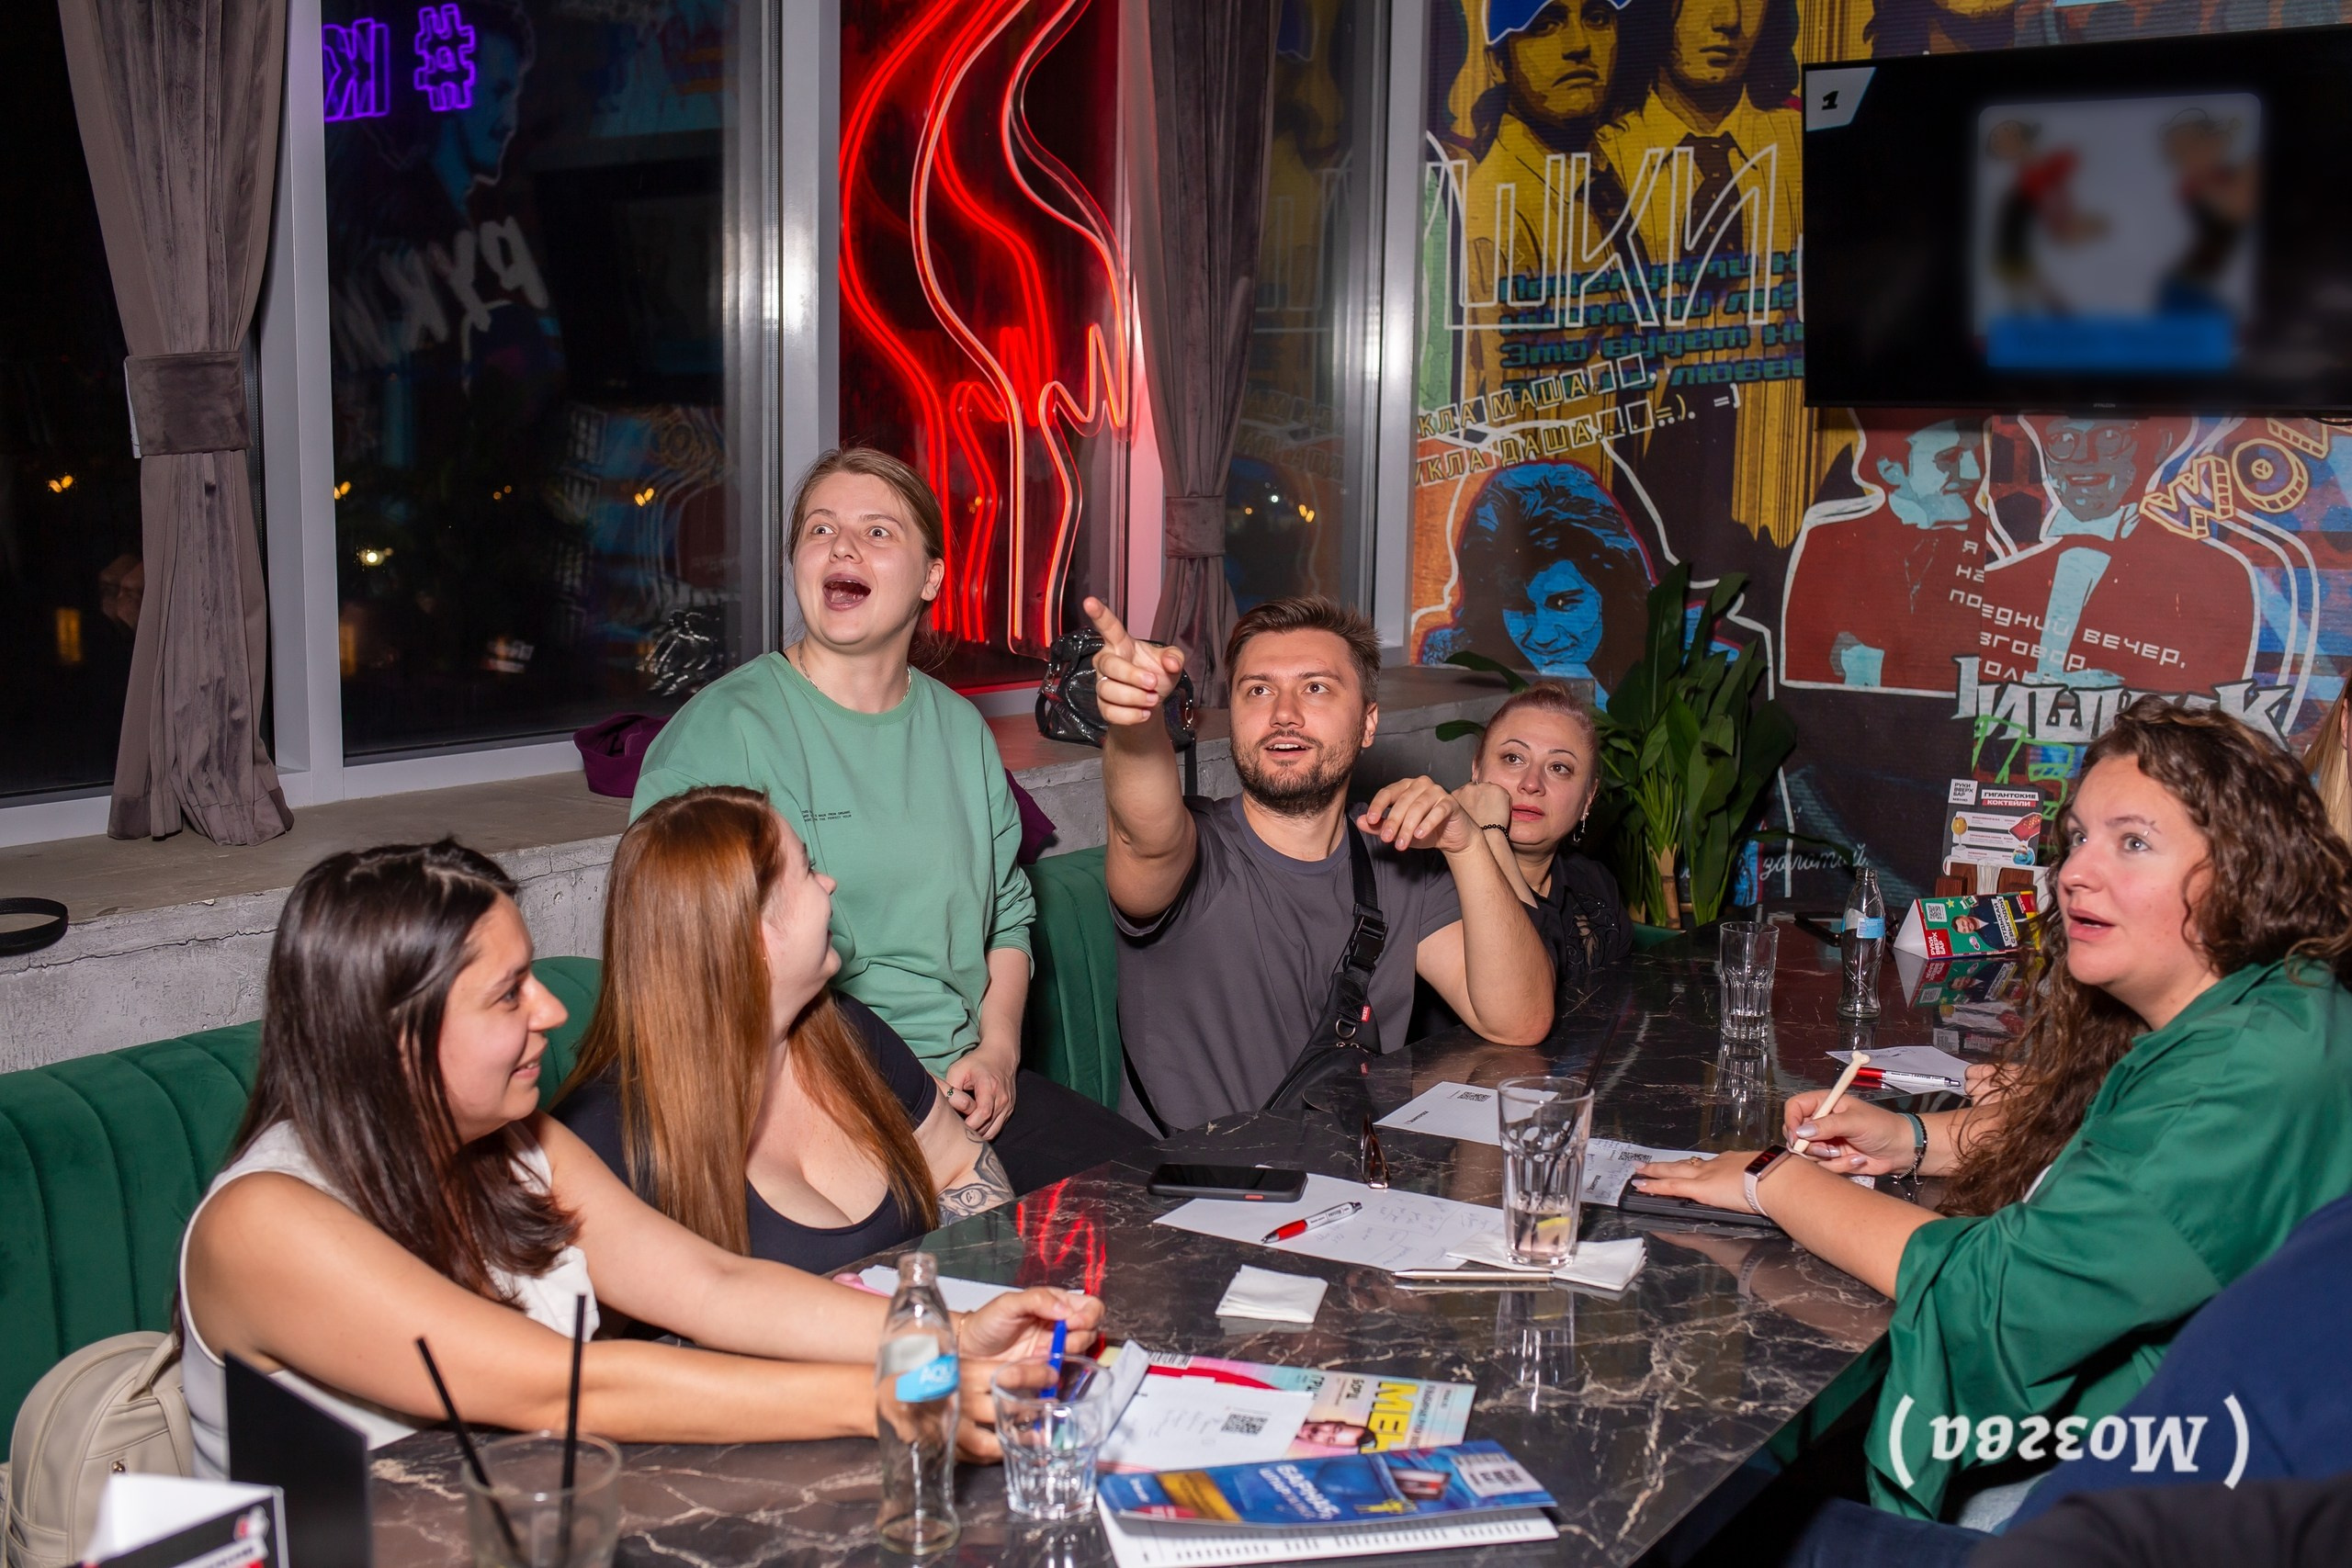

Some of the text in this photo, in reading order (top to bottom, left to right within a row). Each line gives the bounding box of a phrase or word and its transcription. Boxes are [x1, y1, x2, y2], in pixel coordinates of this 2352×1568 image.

[1822, 91, 1838, 110] 1
[1984, 792, 2037, 800] ГИГАНТСКИЕ
[1986, 799, 2031, 807] КОКТЕЙЛИ
[1994, 902, 2008, 942] ОТДЫХАЙ
